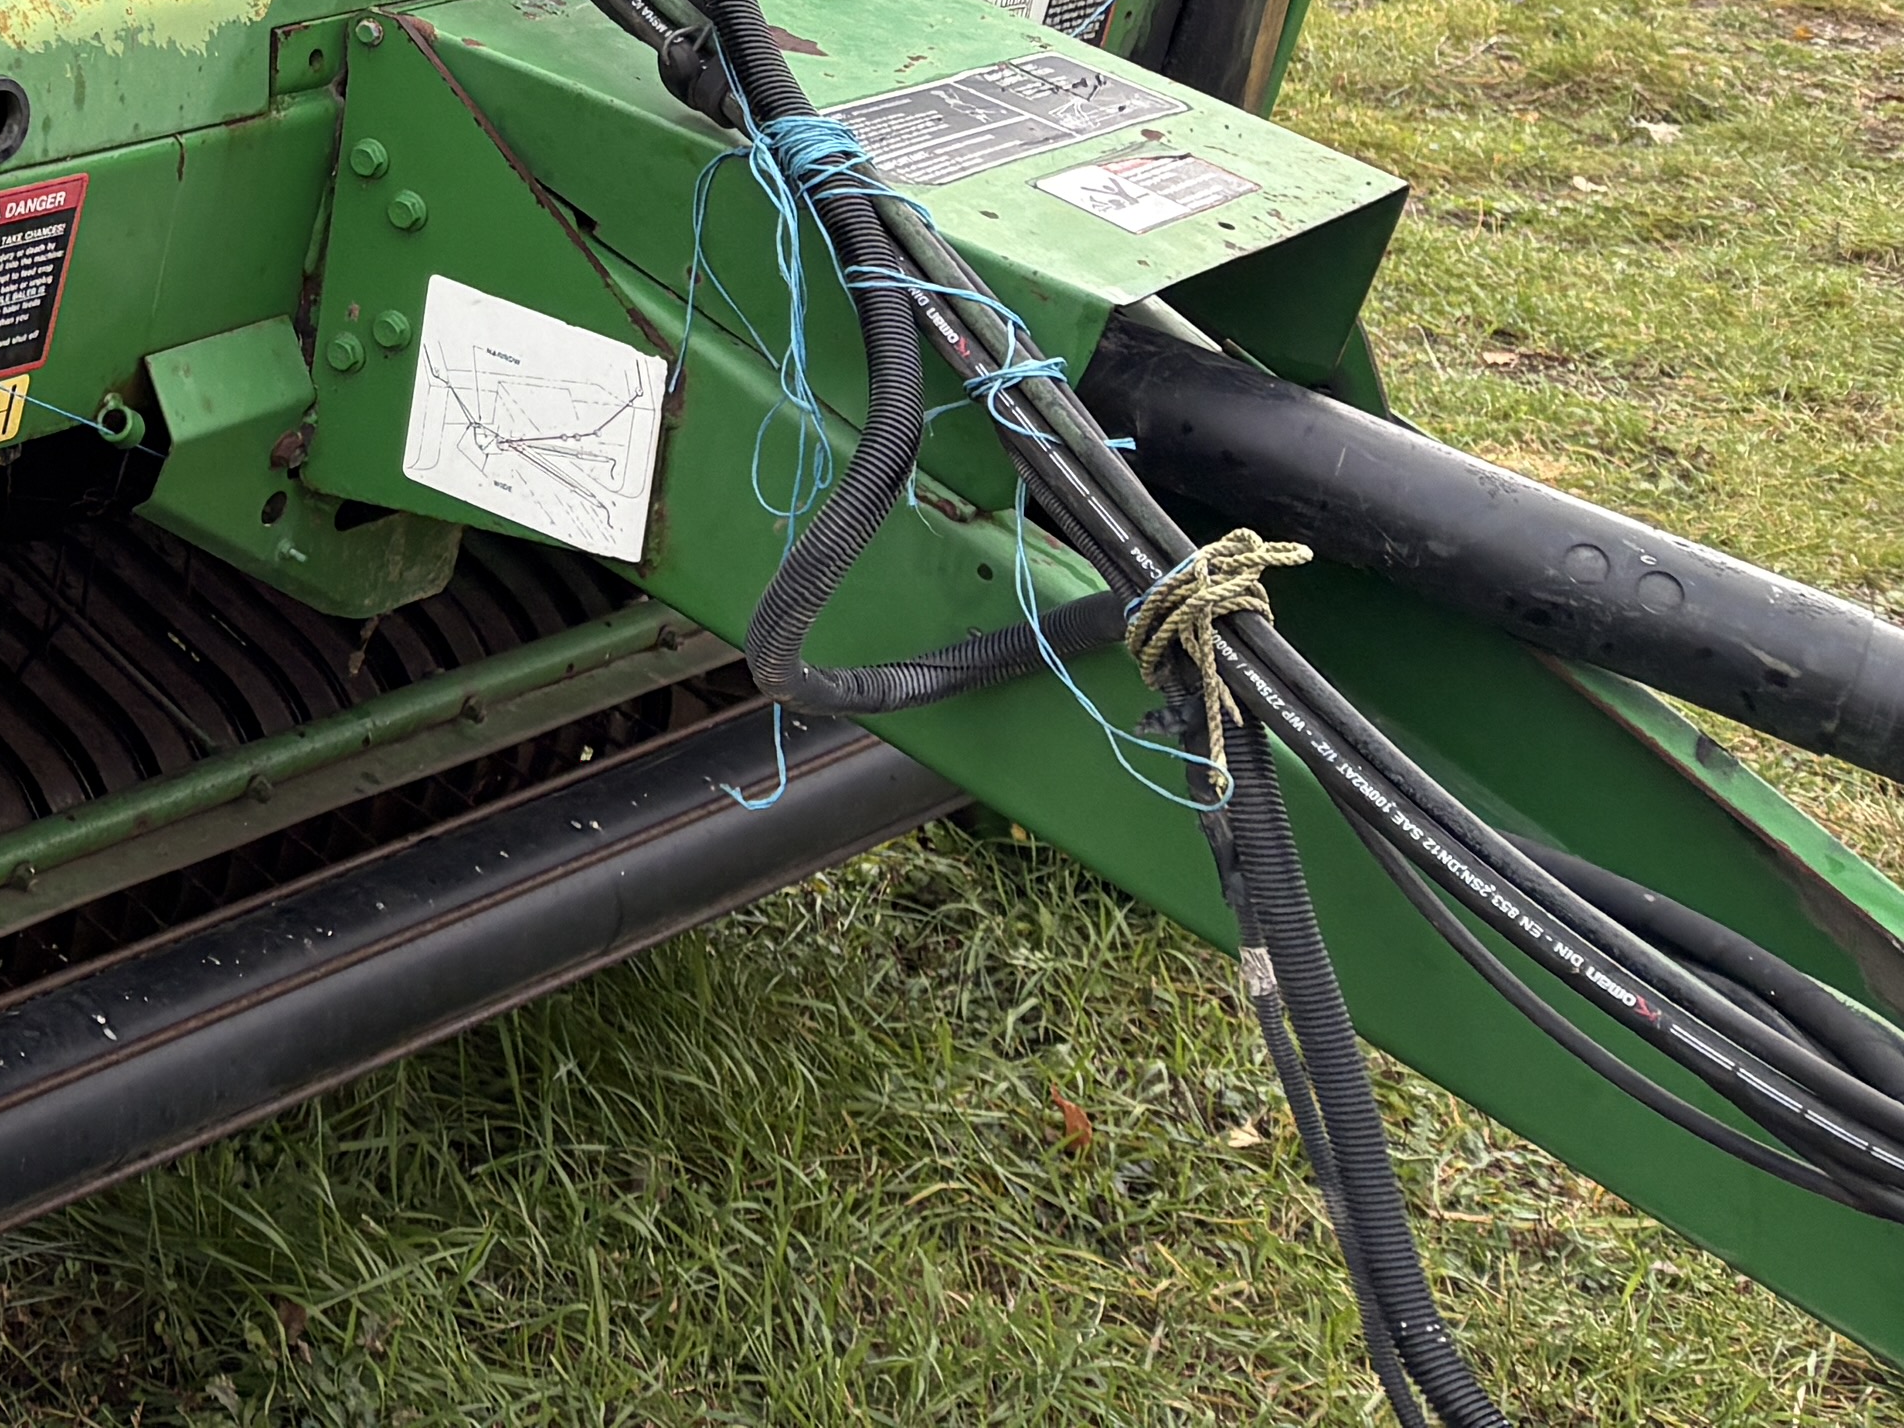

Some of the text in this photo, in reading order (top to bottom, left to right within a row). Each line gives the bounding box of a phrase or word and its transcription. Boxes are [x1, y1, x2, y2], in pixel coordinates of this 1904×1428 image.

[4, 190, 66, 218] DANGER
[926, 307, 971, 358] Koman
[1244, 667, 1286, 709] 275bar
[1281, 710, 1306, 732] WP
[1391, 811, 1424, 841] SAE
[1519, 917, 1545, 939] EN
[1553, 943, 1585, 969] DIN
[1585, 967, 1662, 1024] Koman
